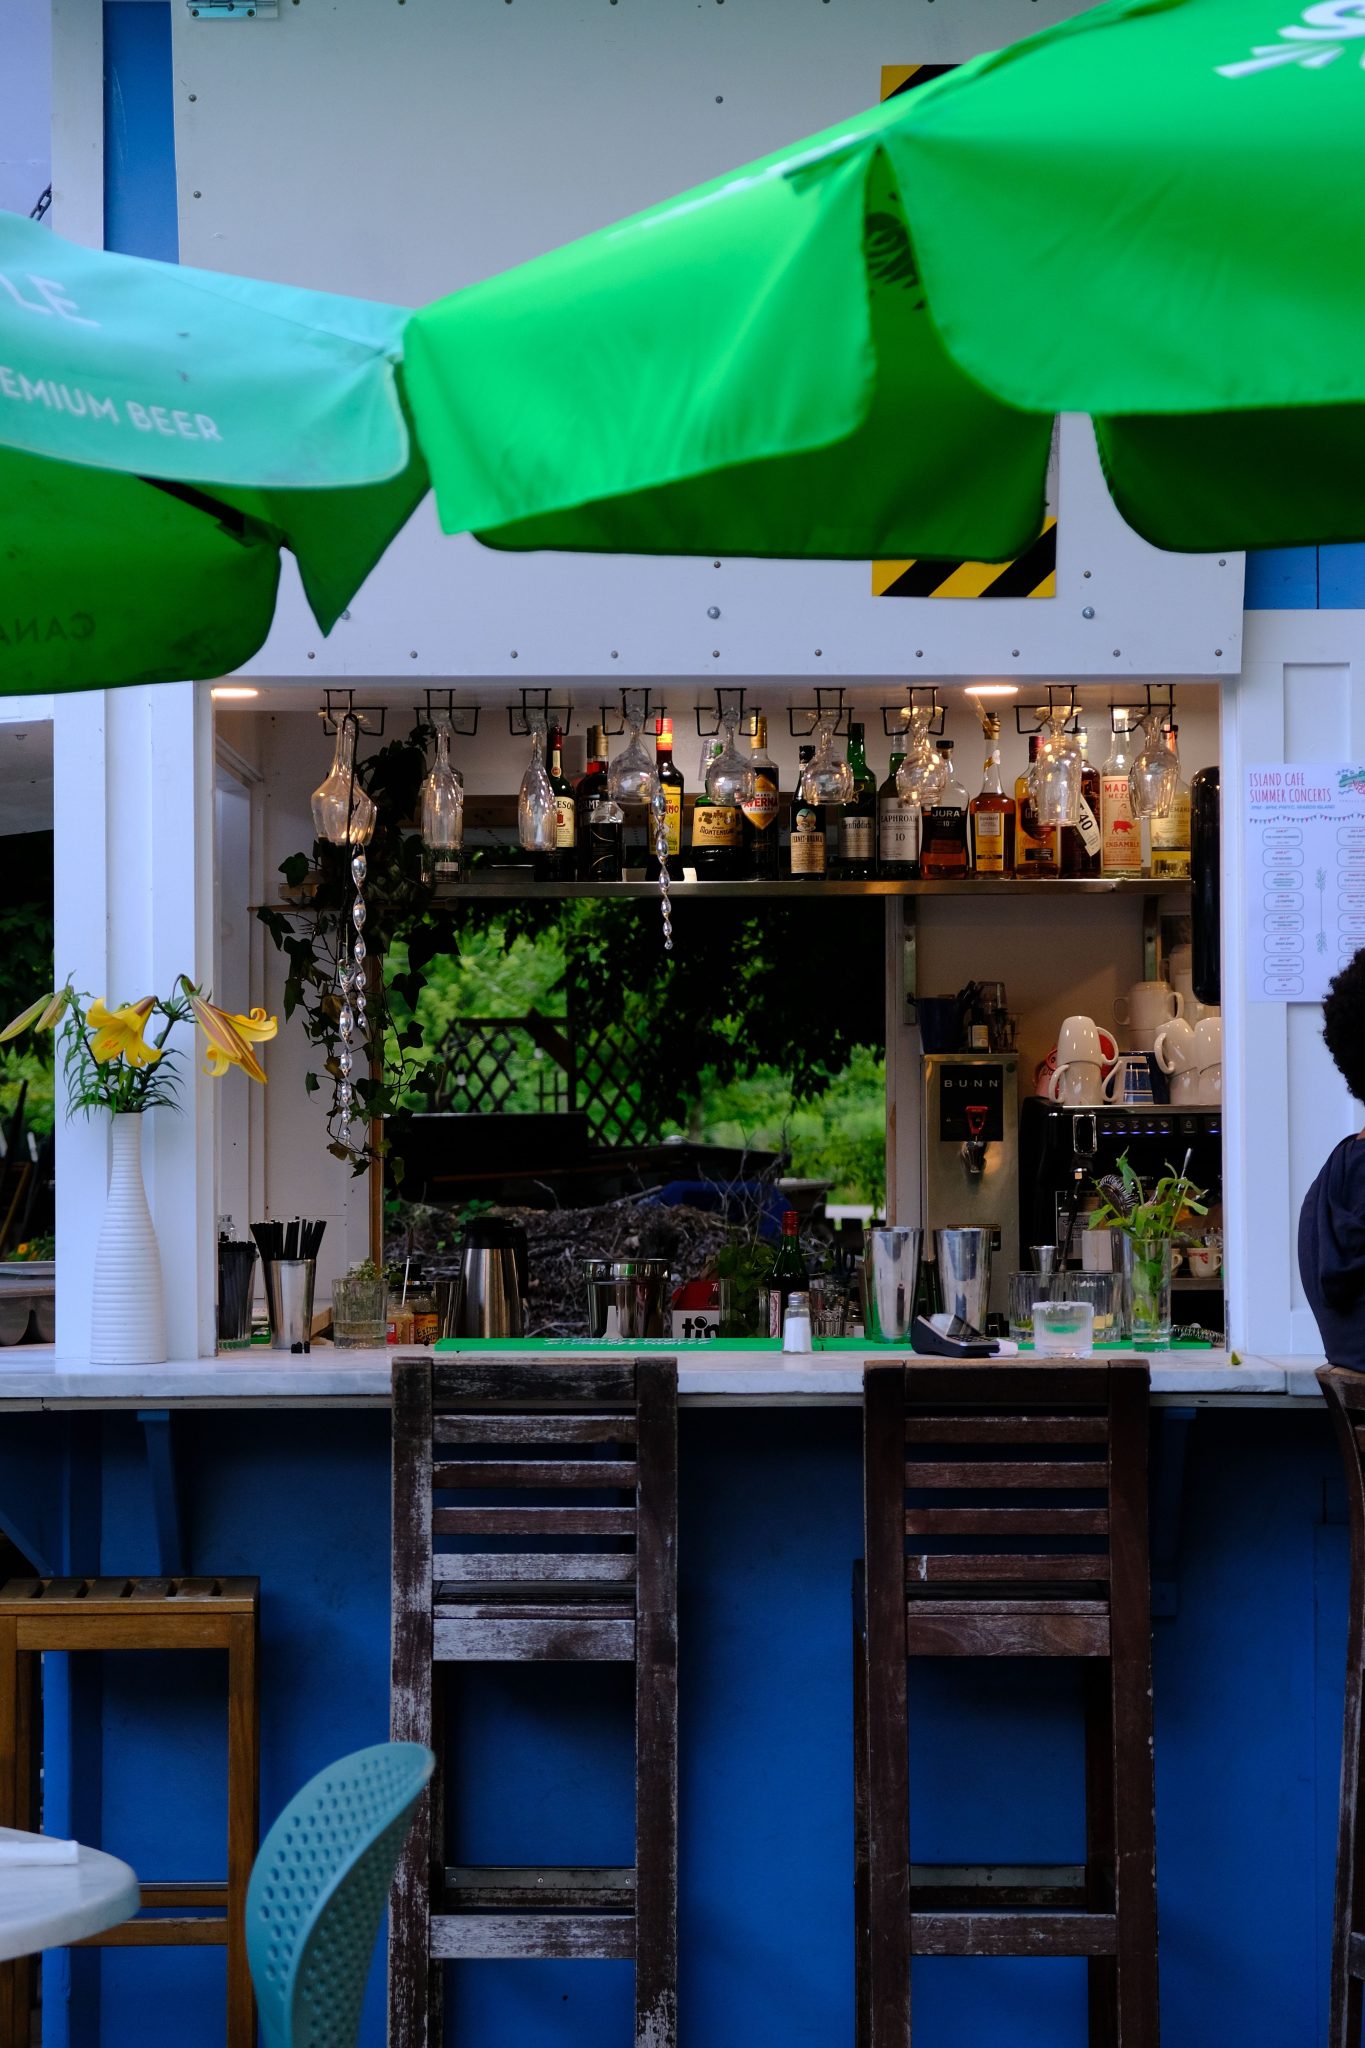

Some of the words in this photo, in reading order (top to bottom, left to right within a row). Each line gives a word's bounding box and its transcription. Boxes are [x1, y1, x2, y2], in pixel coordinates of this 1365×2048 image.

[0, 366, 119, 425] EMIUM
[126, 401, 223, 441] BEER
[1249, 773, 1281, 786] ISLAND
[1285, 772, 1305, 786] CAFE
[1104, 783, 1128, 793] MAD
[1250, 789, 1286, 803] SUMMER
[1289, 788, 1332, 802] CONCERTS
[931, 809, 962, 818] JURA
[895, 833, 906, 842] 10
[943, 1079, 999, 1088] BUNN
